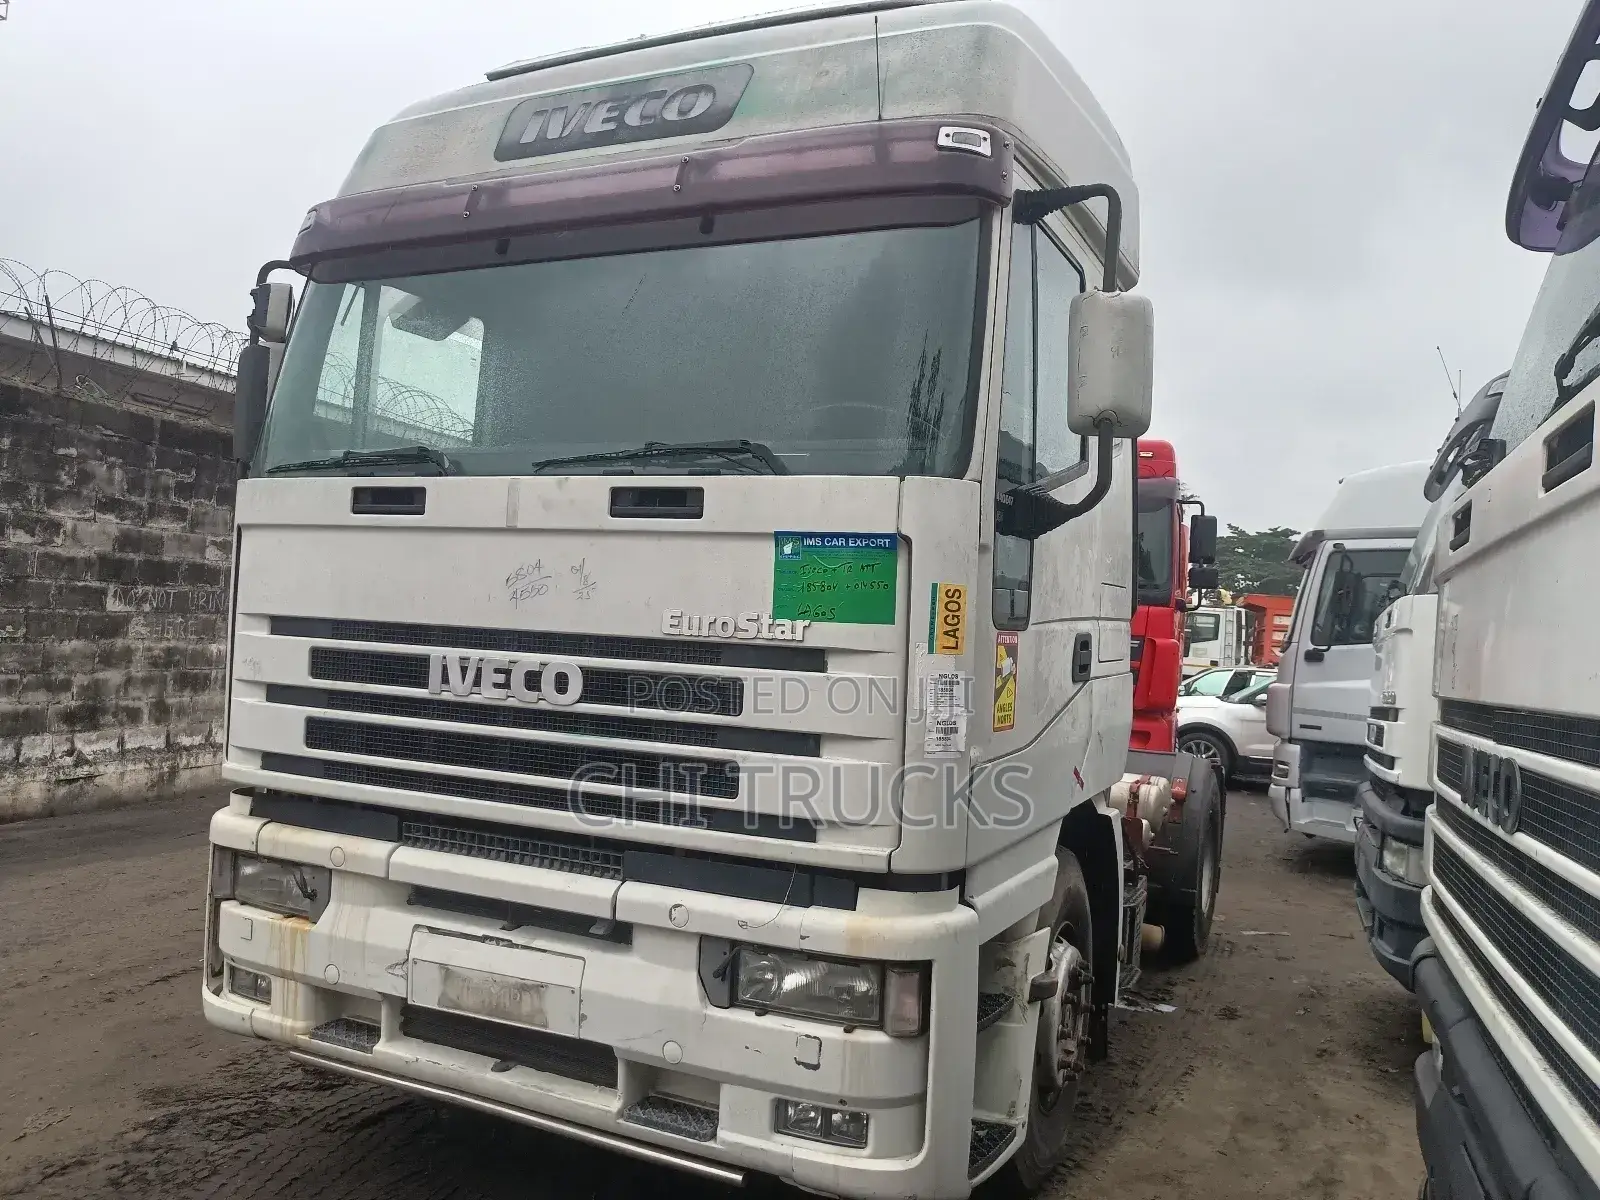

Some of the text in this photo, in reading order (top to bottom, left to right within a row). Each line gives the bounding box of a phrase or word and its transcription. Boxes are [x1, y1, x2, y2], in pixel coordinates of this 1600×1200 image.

[519, 83, 717, 144] IVECO
[803, 537, 891, 548] IMS CAR EXPORT
[148, 588, 178, 608] NOT
[661, 607, 811, 643] EuroStar
[942, 588, 962, 650] LAGOS
[997, 634, 1017, 644] ATTENTION
[428, 653, 584, 707] IVECO
[996, 702, 1012, 713] ANGLES
